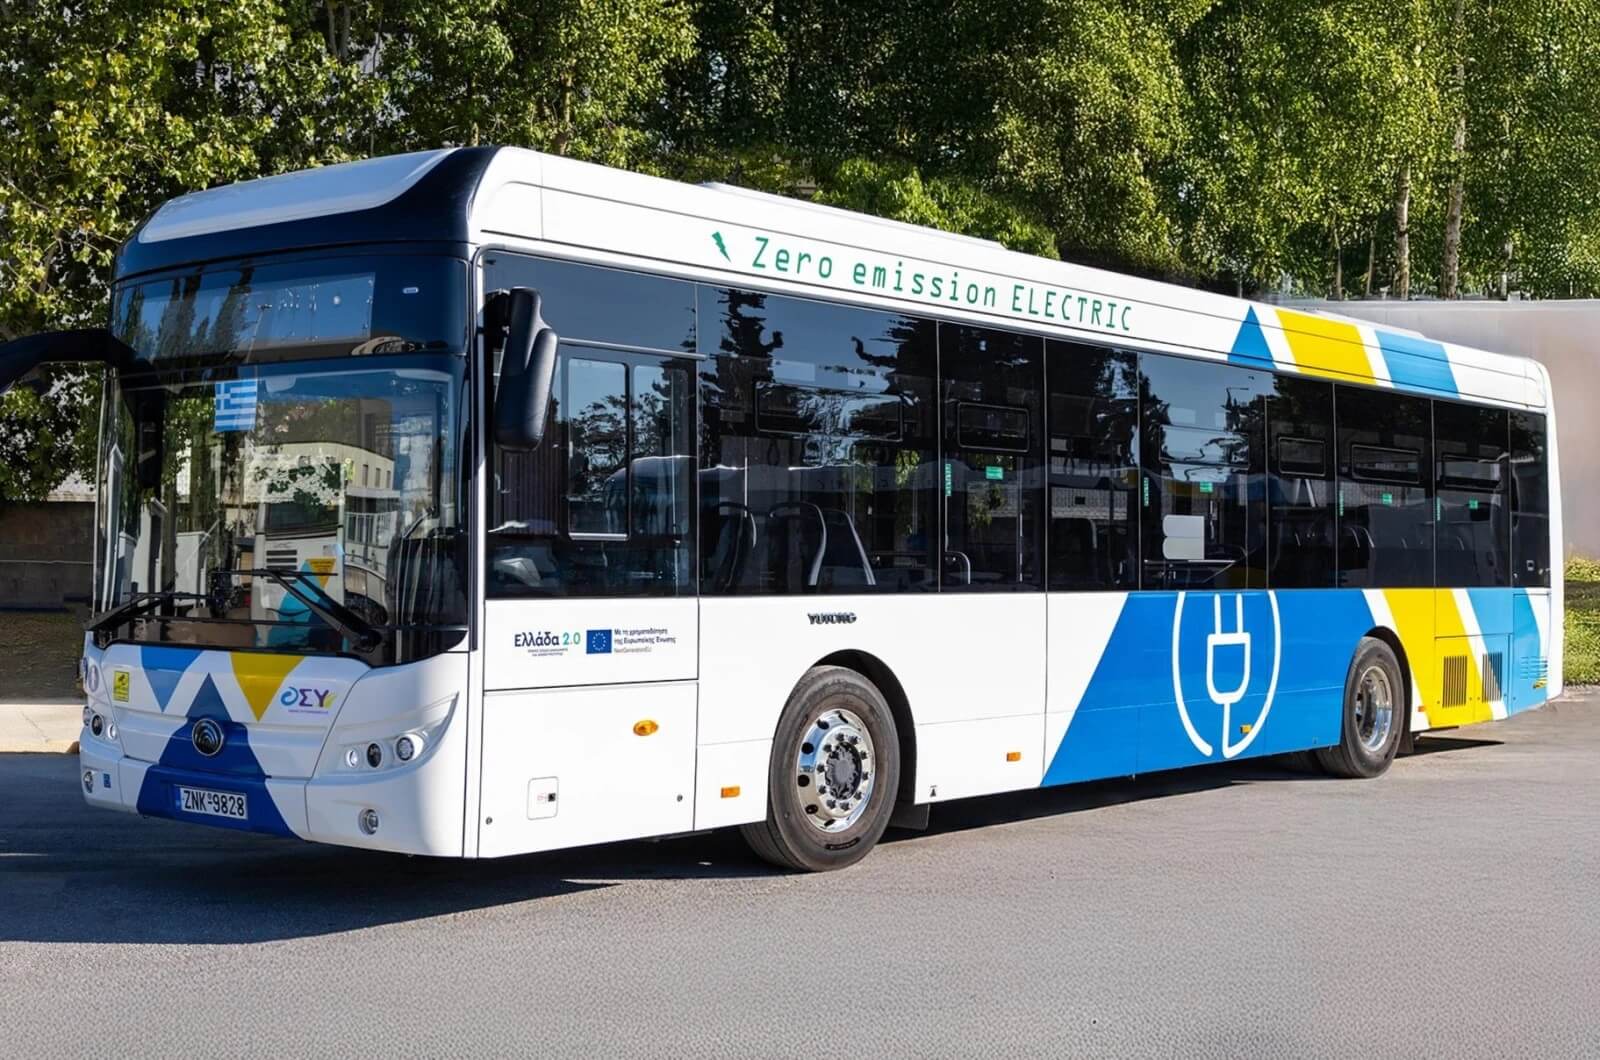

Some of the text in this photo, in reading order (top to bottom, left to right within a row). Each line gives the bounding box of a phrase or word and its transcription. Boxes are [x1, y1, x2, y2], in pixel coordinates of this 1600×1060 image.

[752, 236, 1133, 332] Zero emission ELECTRIC
[514, 631, 581, 647] Ελλάδα 2.0
